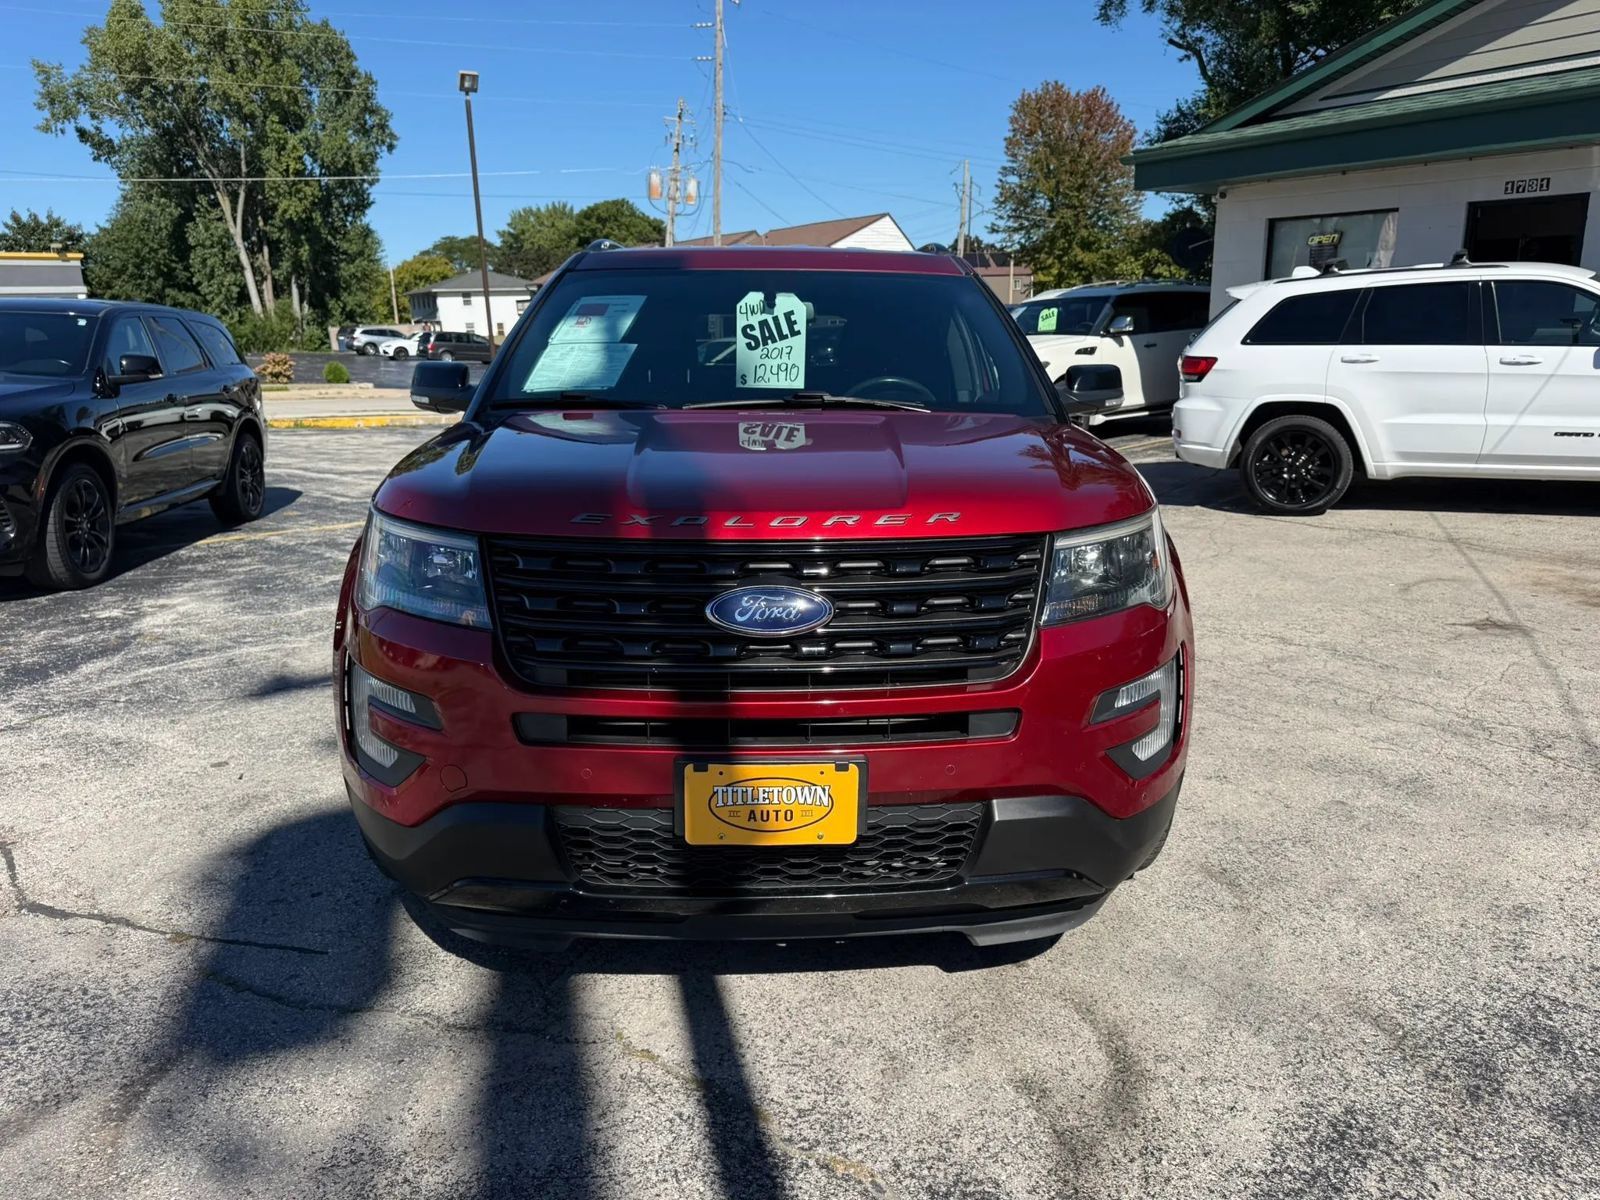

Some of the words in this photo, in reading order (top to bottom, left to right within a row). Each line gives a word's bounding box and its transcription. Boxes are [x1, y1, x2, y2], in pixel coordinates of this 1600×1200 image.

[1504, 177, 1551, 194] 1731
[1308, 234, 1338, 245] OPEN
[1041, 311, 1056, 322] SALE
[741, 309, 802, 351] SALE
[760, 345, 793, 360] 2017
[740, 373, 748, 386] $
[753, 362, 800, 383] 12,490
[569, 511, 962, 528] EXPLORER
[734, 595, 802, 622] Ford
[713, 784, 831, 807] TITLETOWN
[747, 809, 794, 822] AUTO
